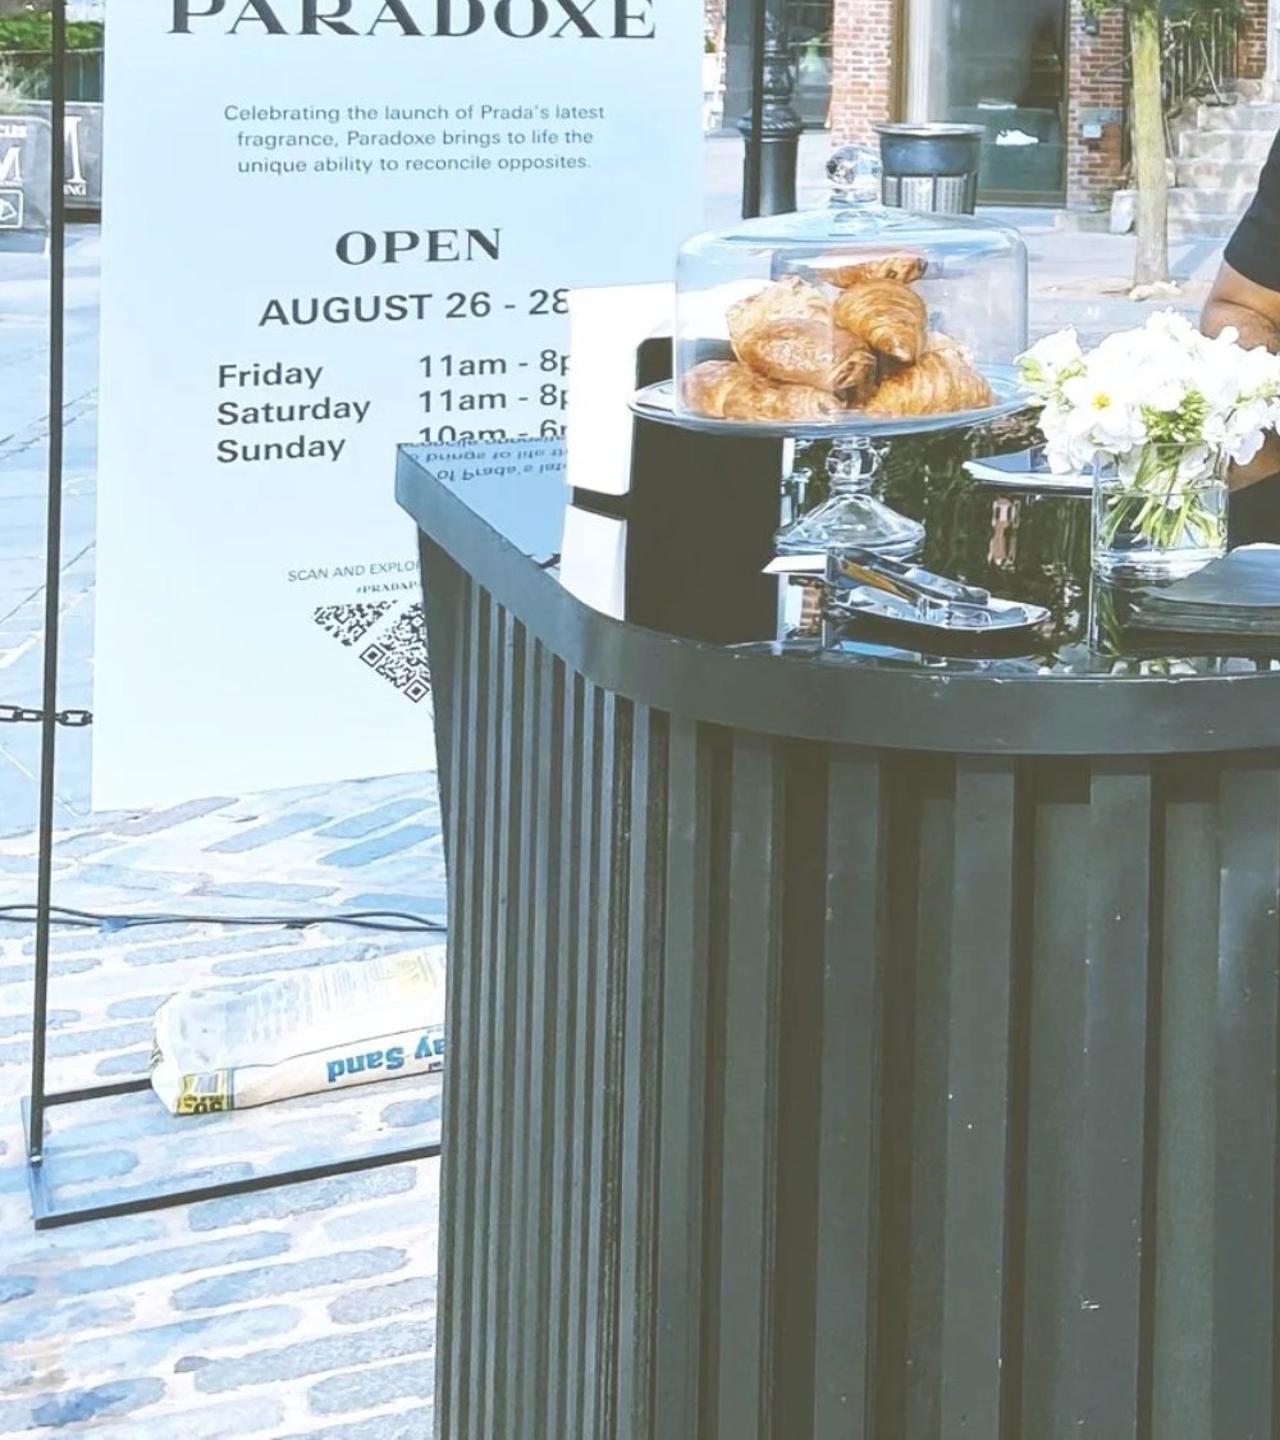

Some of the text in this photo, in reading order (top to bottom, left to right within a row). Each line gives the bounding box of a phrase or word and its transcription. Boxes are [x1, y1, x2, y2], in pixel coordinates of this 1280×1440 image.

[224, 104, 605, 124] Celebrating the launch of Prada's latest
[237, 129, 594, 150] fragrance, Paradoxe brings to life the
[238, 155, 592, 176] unique ability to reconcile opposites.
[335, 228, 500, 266] OPEN
[259, 293, 433, 327] AUGUST
[446, 291, 492, 319] 26
[218, 362, 323, 389] Friday
[419, 354, 507, 378] 11am
[217, 396, 371, 426] Saturday
[419, 389, 507, 413] 11am
[217, 435, 346, 464] Sunday
[288, 560, 418, 582] SCAN AND EXPLO
[327, 1046, 405, 1083] Sand
